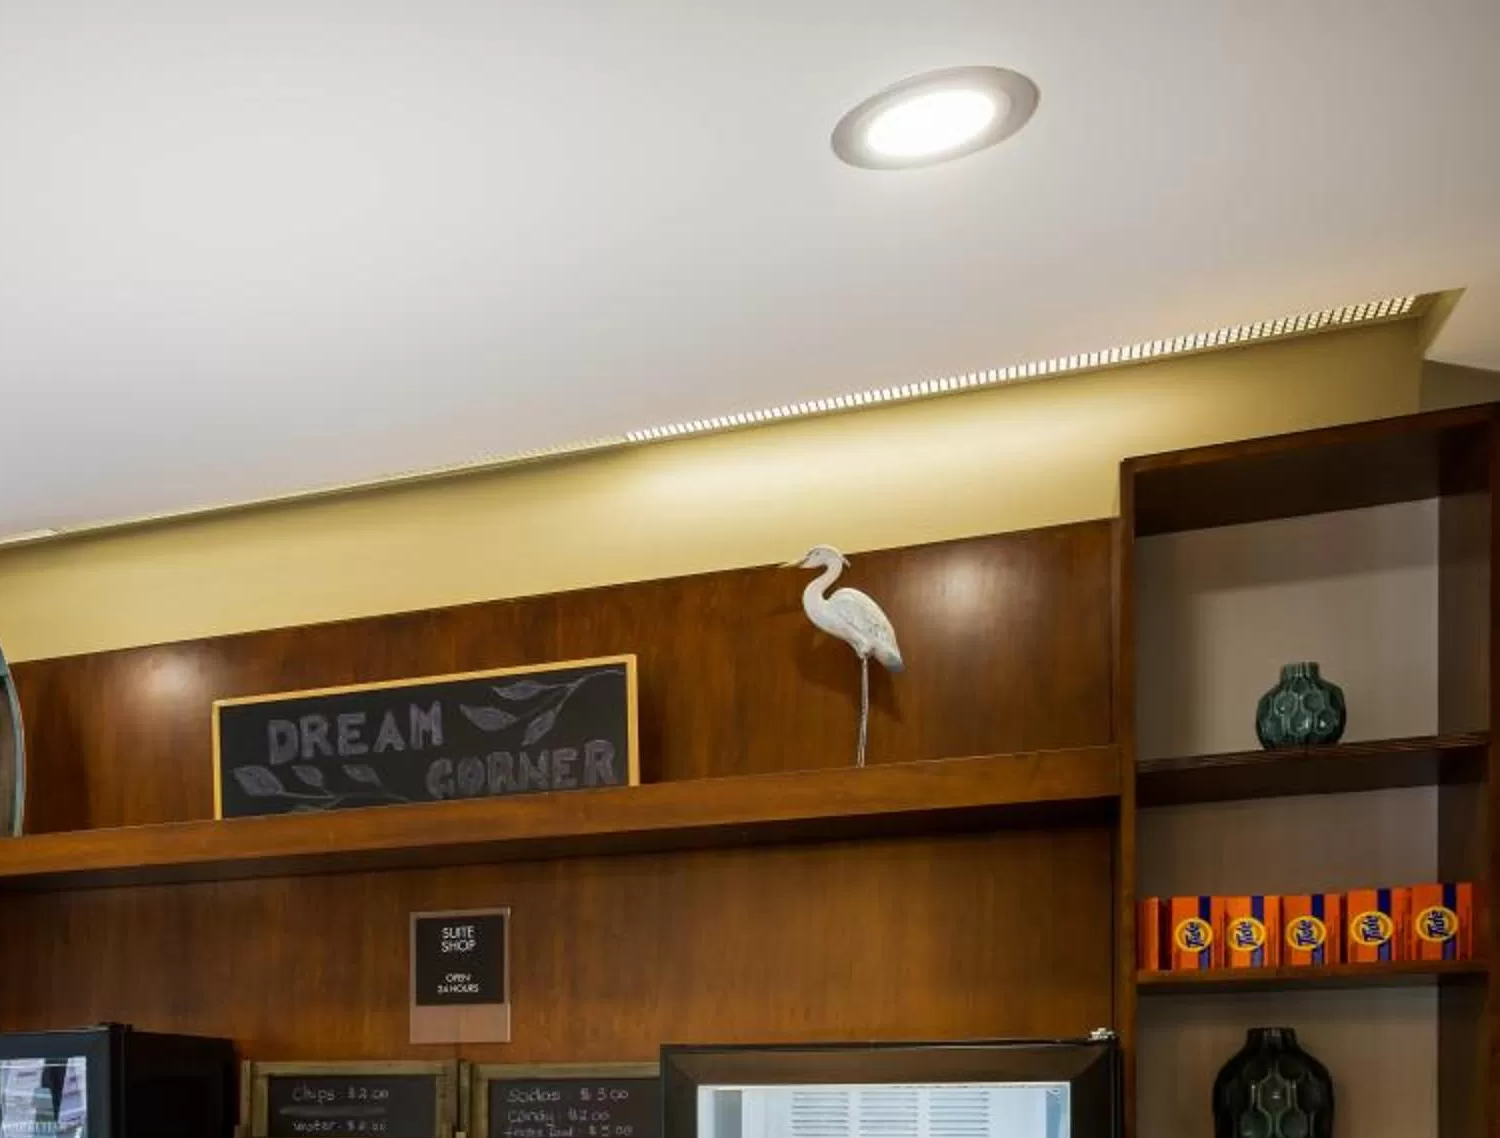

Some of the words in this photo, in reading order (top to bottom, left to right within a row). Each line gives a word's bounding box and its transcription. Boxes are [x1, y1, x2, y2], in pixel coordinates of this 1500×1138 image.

[266, 701, 445, 765] DREAM
[425, 739, 619, 799] CORNER
[441, 939, 477, 953] SHOP
